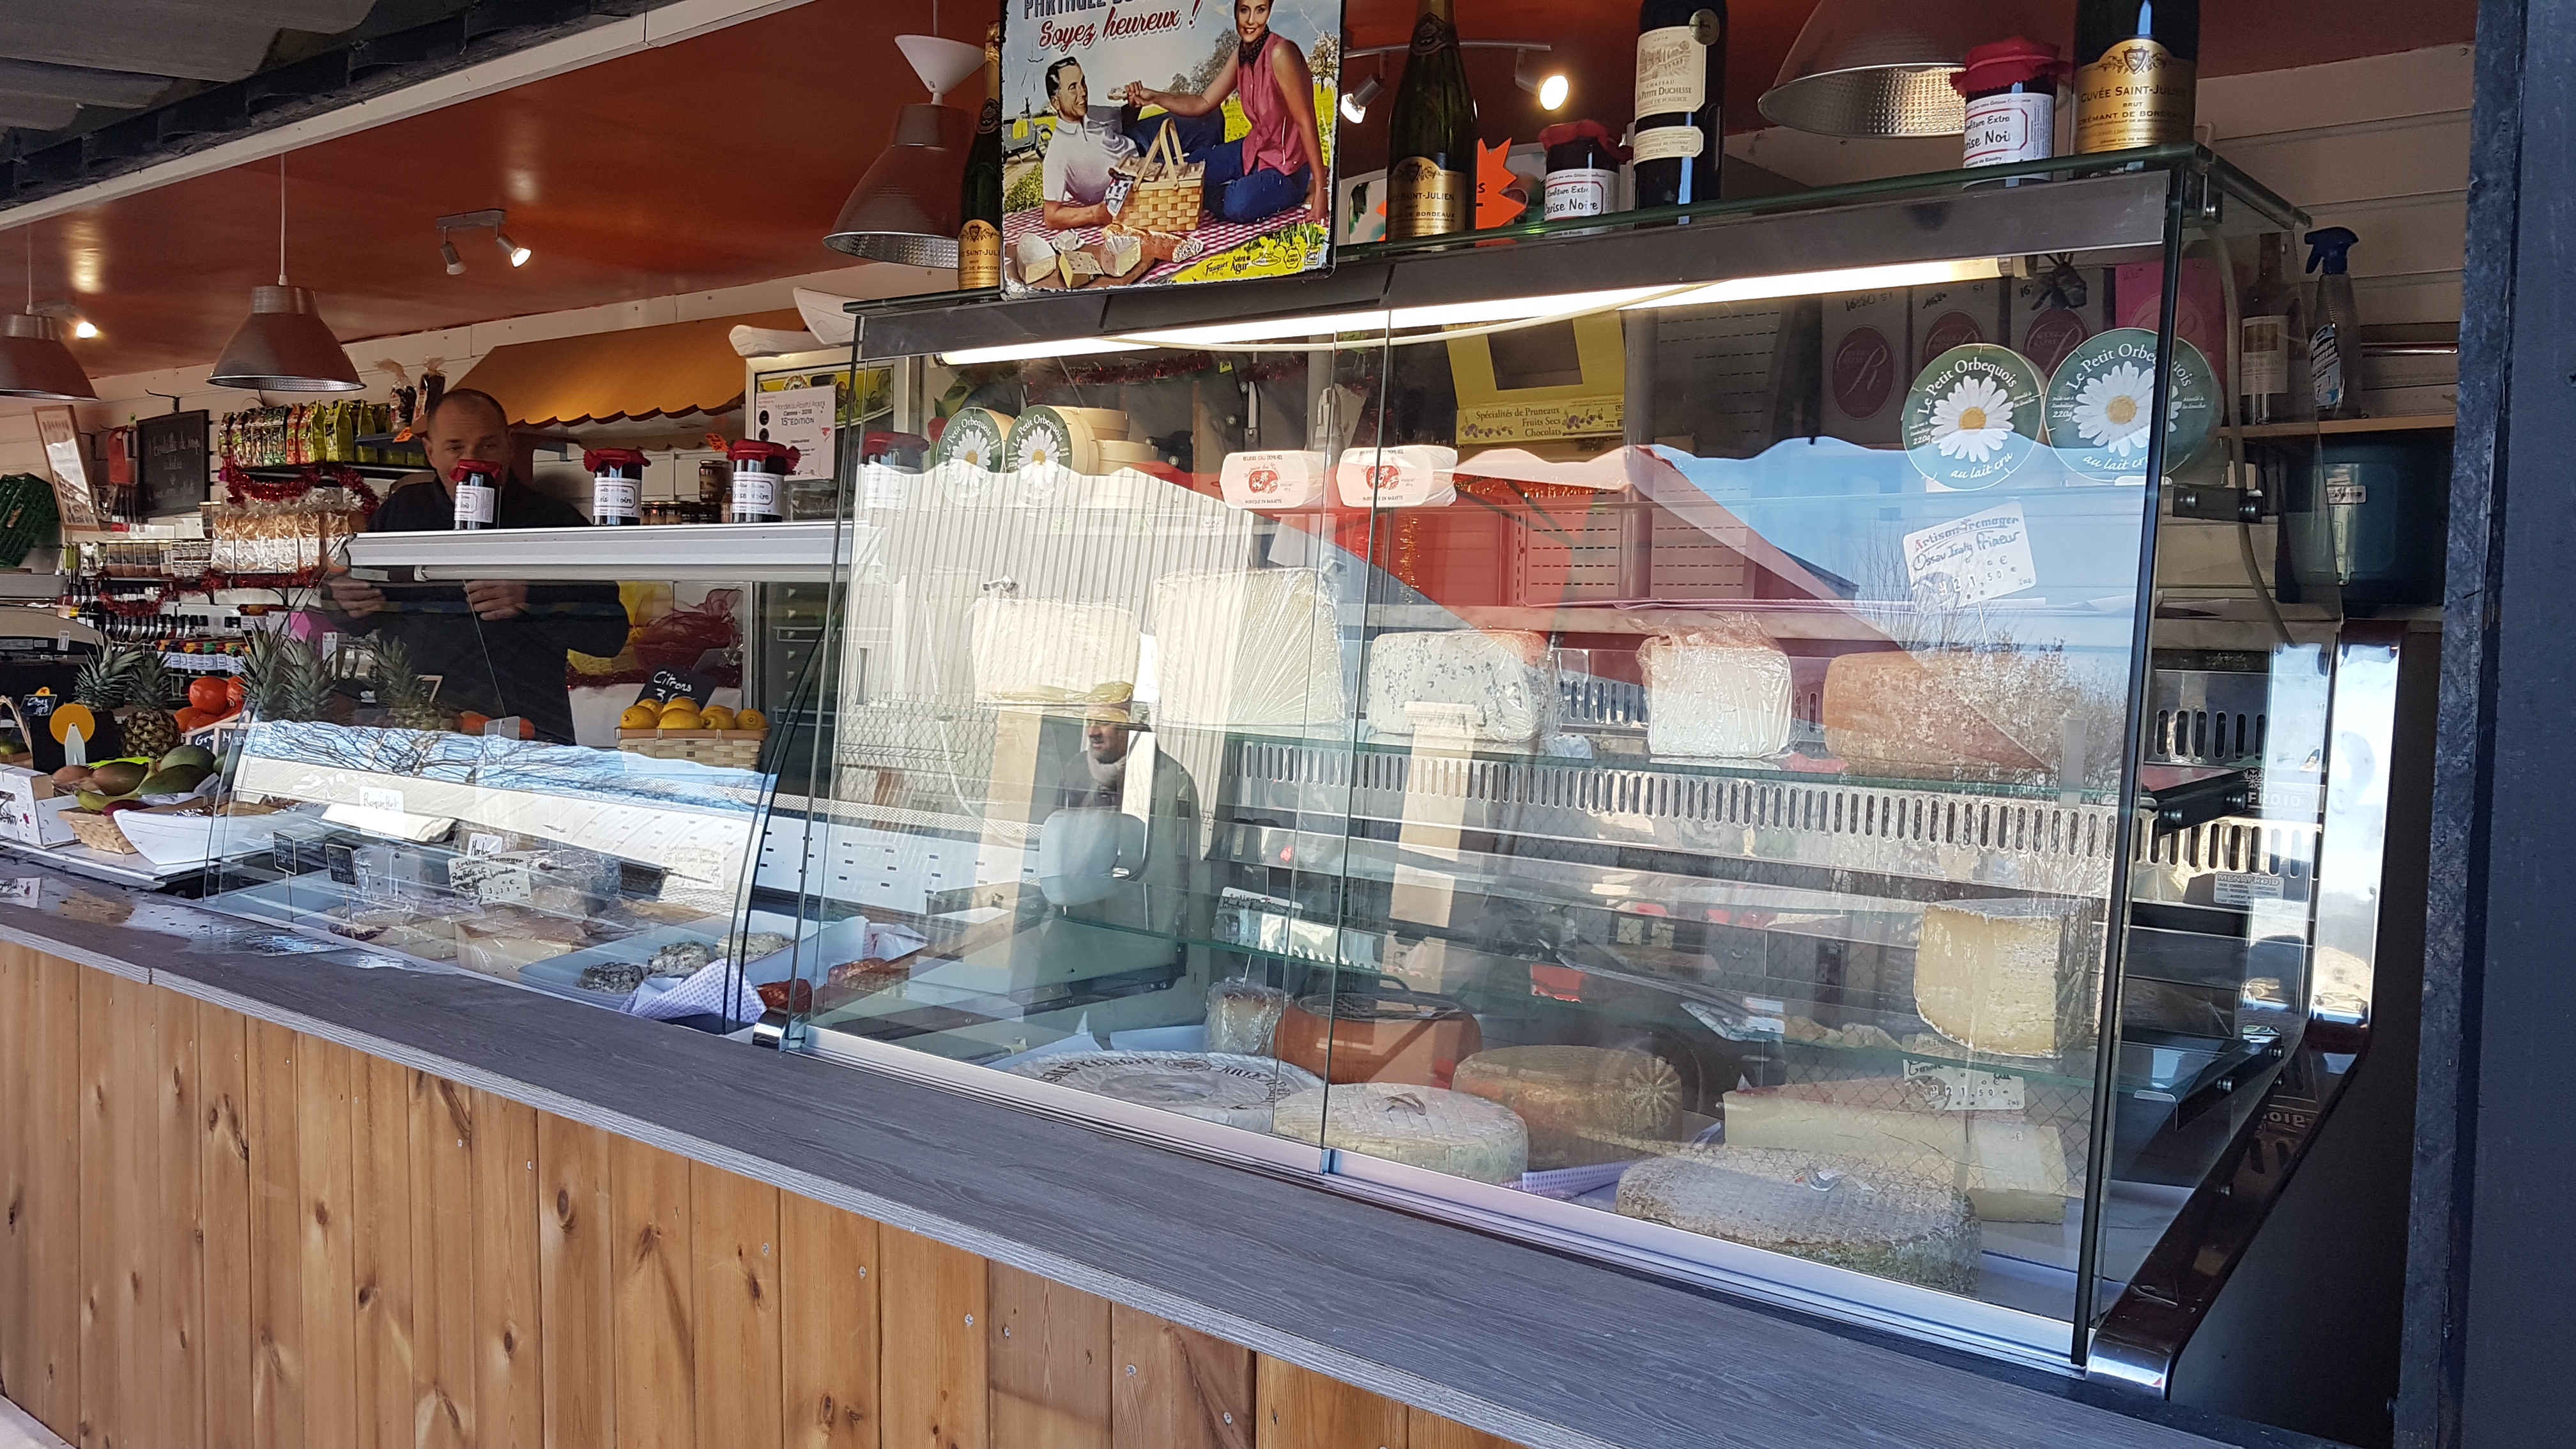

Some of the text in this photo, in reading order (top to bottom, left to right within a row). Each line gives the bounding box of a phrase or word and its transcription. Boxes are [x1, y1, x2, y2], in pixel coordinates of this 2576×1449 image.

[1039, 20, 1096, 53] Soyez
[1102, 6, 1181, 38] heureux
[1659, 86, 1692, 95] DUCHESSE
[2080, 87, 2112, 103] CUVÉE
[1987, 115, 2010, 125] Extra
[2078, 112, 2119, 126] CRÉMANT
[1230, 261, 1249, 275] Agur
[2066, 342, 2193, 391] Le Petit Orbeois
[1917, 356, 2018, 415] Le Petit Orbequois
[1476, 407, 1560, 422] Spécialités de Pruneaux
[1522, 417, 1561, 427] Fruits Secs
[2052, 410, 2073, 422] 220g
[944, 416, 992, 456] Le Petit Orbequois
[1012, 413, 1063, 448] Le Petit Orbequois
[1524, 427, 1562, 437] Chocolats
[1913, 434, 1931, 445] 220g
[1951, 452, 2014, 479] au lait cru
[2083, 455, 2102, 467] au
[2103, 458, 2129, 470] lait
[1914, 527, 1959, 553] Artisan
[1913, 552, 1946, 571] Ossau
[653, 671, 693, 693] Citrons
[2217, 874, 2280, 886] MENAFROID
